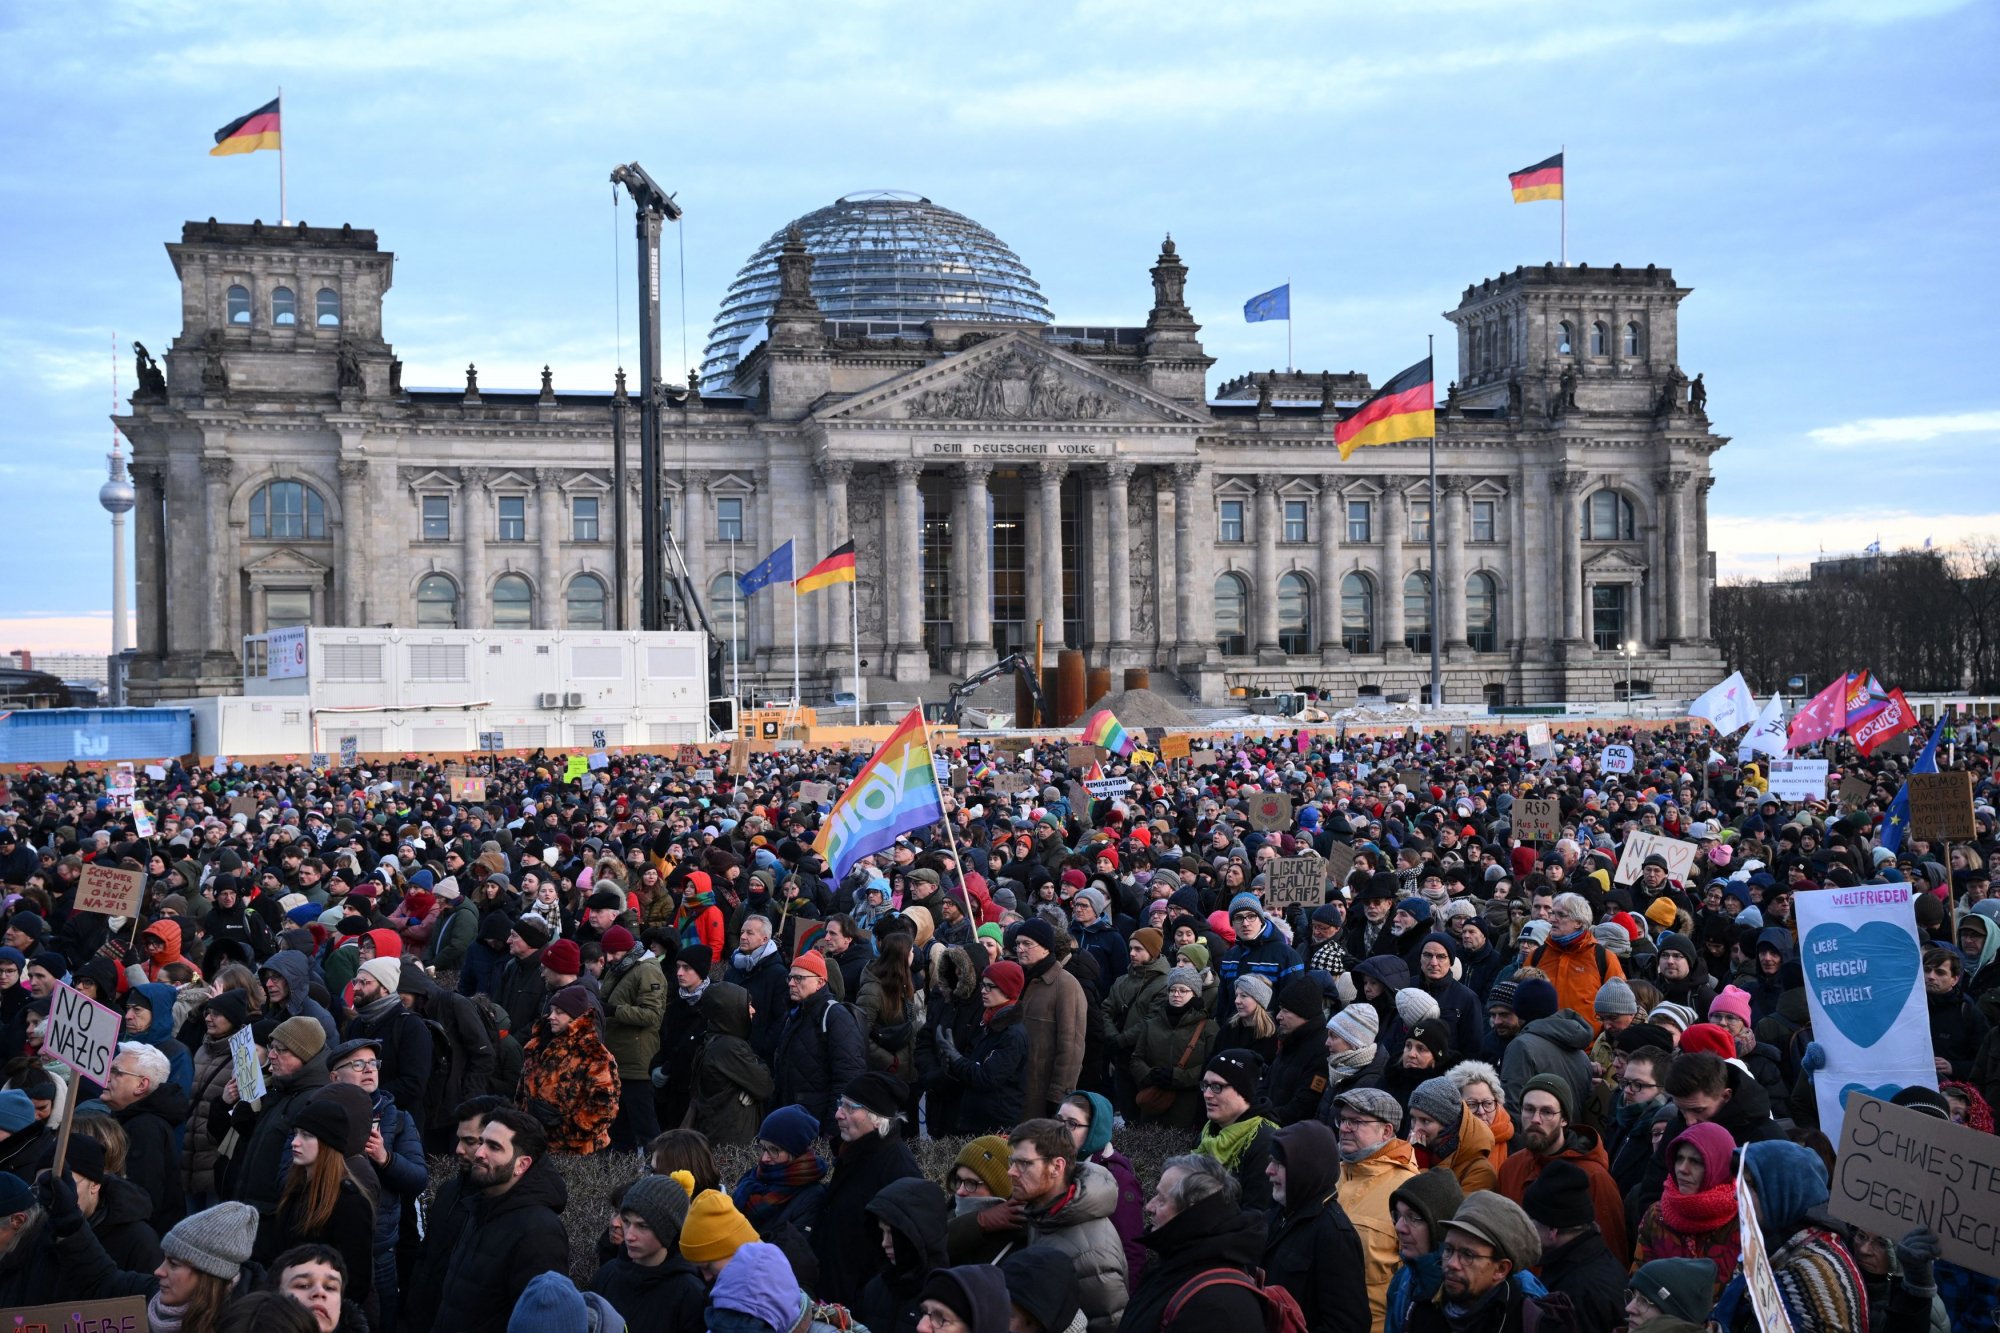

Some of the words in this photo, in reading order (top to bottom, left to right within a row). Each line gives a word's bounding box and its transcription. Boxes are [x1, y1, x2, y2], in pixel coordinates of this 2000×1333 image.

[651, 248, 659, 301] LIEBHERR
[933, 443, 962, 453] DEM
[973, 443, 1047, 453] DEUTSCHEN
[1057, 444, 1096, 454] VOLKE
[592, 730, 605, 739] FCK
[593, 738, 606, 749] AFD
[681, 746, 695, 754] FCK
[1608, 748, 1628, 758] EKEL
[1607, 759, 1626, 769] HAFD
[1085, 778, 1127, 789] REMIGRATION
[1911, 776, 1964, 788] MEMO:
[87, 877, 133, 893] LEBEN
[91, 888, 127, 900] OHNE
[1831, 888, 1909, 906] WELTFRIEDEN
[82, 897, 128, 911] NAZIS
[1812, 938, 1839, 955] LIEBE
[1815, 959, 1868, 978] FRIEDEN
[1820, 985, 1873, 1006] FREIHEIT
[56, 986, 94, 1032] NO
[49, 1019, 110, 1076] NAZIS
